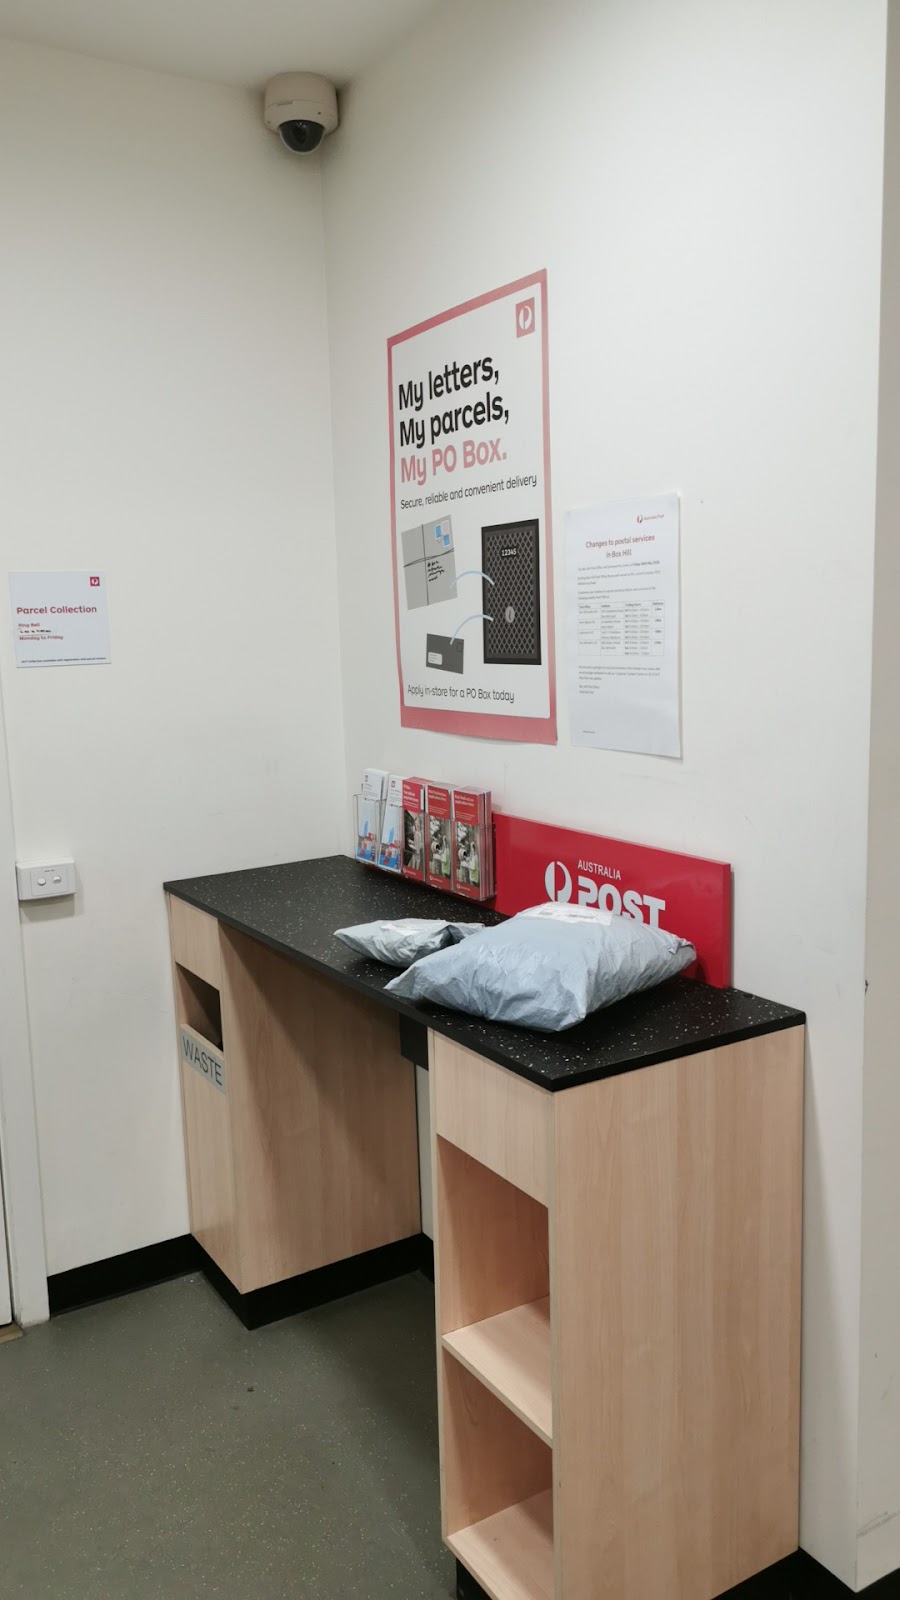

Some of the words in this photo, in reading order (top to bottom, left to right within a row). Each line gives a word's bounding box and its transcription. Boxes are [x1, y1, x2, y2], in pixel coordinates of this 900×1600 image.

[398, 380, 424, 412] My
[429, 357, 499, 400] letters,
[399, 417, 426, 449] My
[430, 392, 508, 445] parcels,
[400, 454, 427, 486] My
[432, 445, 456, 475] PO
[463, 438, 507, 468] Box.
[400, 495, 424, 509] Secure,
[425, 491, 448, 505] reliable
[450, 486, 464, 500] and
[464, 481, 504, 497] convenient
[506, 473, 538, 491] delivery
[501, 547, 517, 557] 12345
[585, 540, 608, 549] Changes
[614, 536, 631, 547] postal
[632, 535, 655, 544] services
[611, 550, 622, 558] Box
[622, 549, 632, 557] Hill
[16, 606, 48, 614] Parcel
[50, 605, 97, 614] Collection
[407, 685, 424, 698] Apply
[424, 684, 448, 698] in-store
[449, 686, 458, 698] for
[459, 689, 465, 698] a
[466, 687, 477, 699] PO
[477, 688, 492, 700] Box
[492, 688, 515, 704] today
[577, 858, 622, 881] AUSTRALIA
[577, 875, 666, 929] POST
[182, 1036, 223, 1087] WASTE
